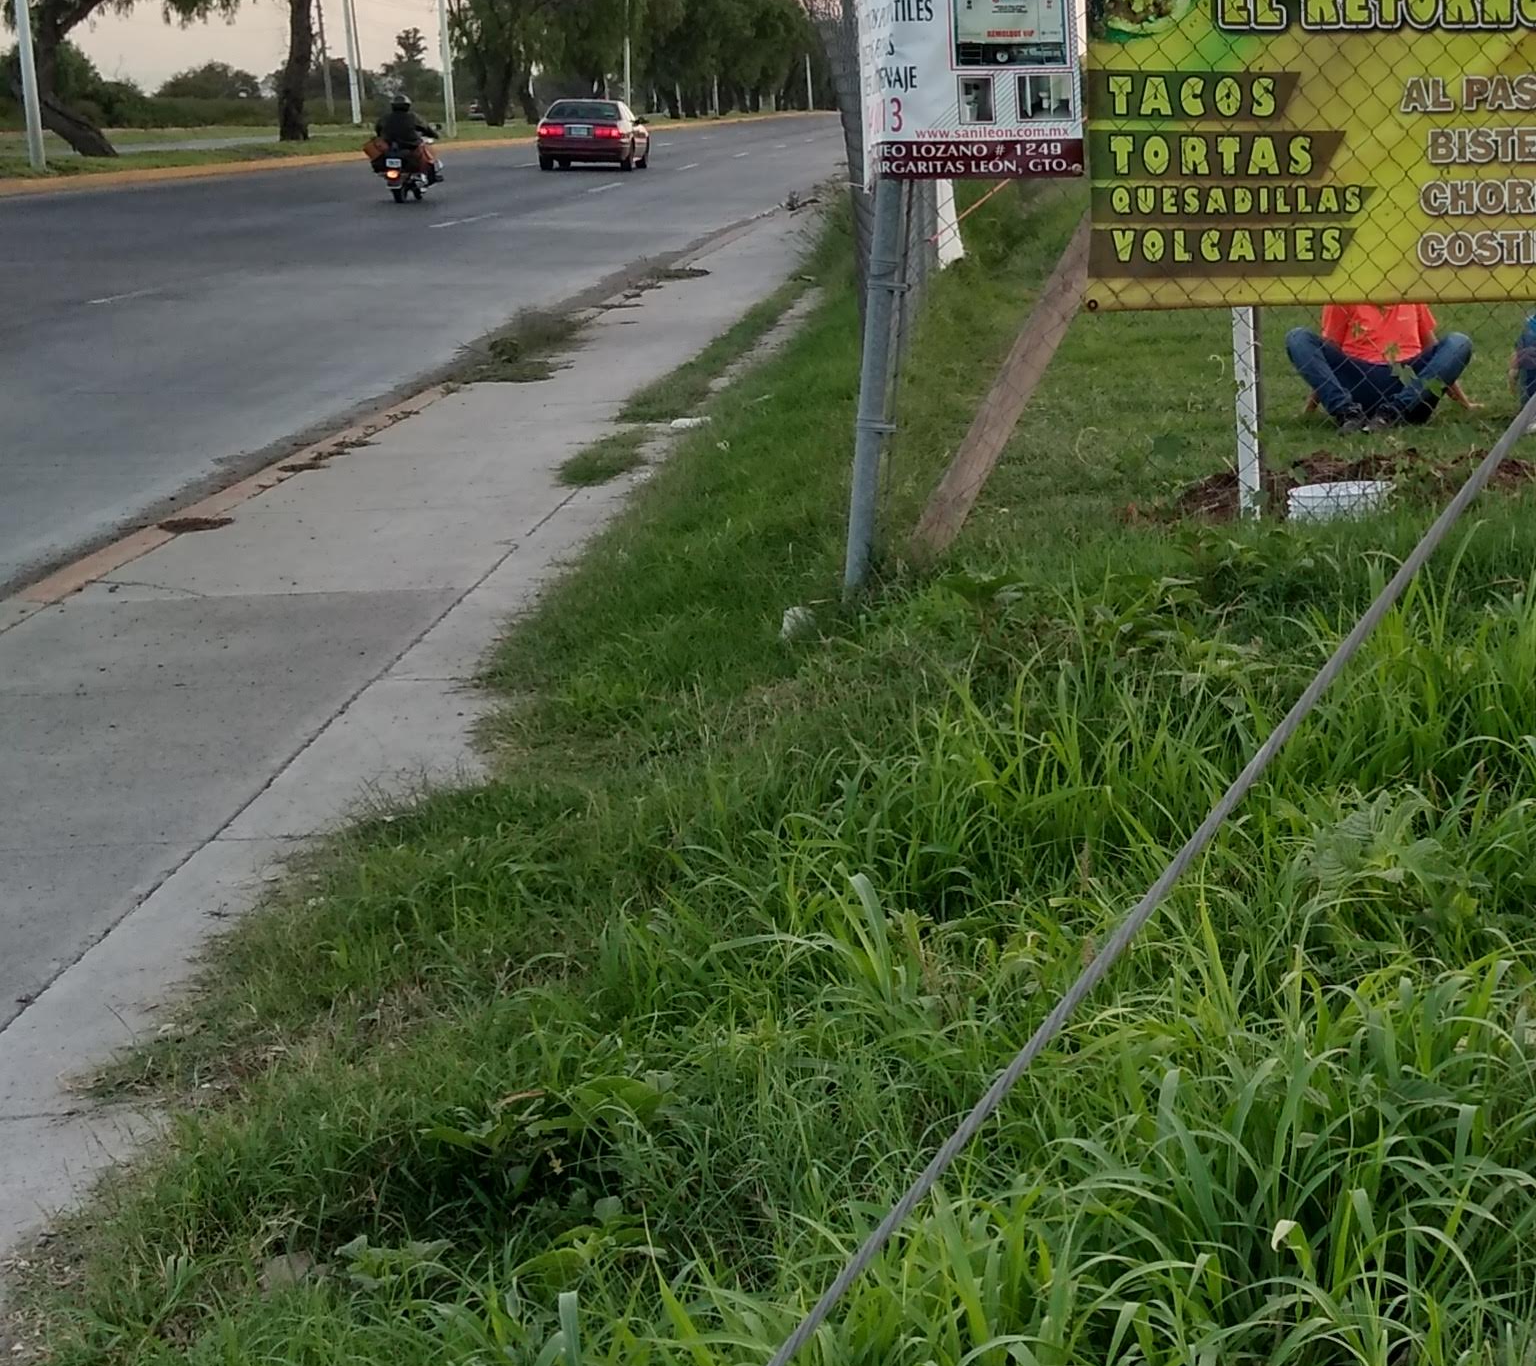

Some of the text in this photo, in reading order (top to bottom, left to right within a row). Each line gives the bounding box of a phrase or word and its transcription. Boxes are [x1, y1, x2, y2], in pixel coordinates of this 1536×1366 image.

[1108, 75, 1276, 117] TACOS
[1402, 77, 1453, 112] AL
[915, 126, 1071, 140] www.sanileon.com.mx
[912, 144, 988, 158] LOZANO
[1110, 134, 1313, 176] TORTAS
[1111, 184, 1363, 216] QUESADILLAS
[1112, 226, 1343, 263] VOLCANES
